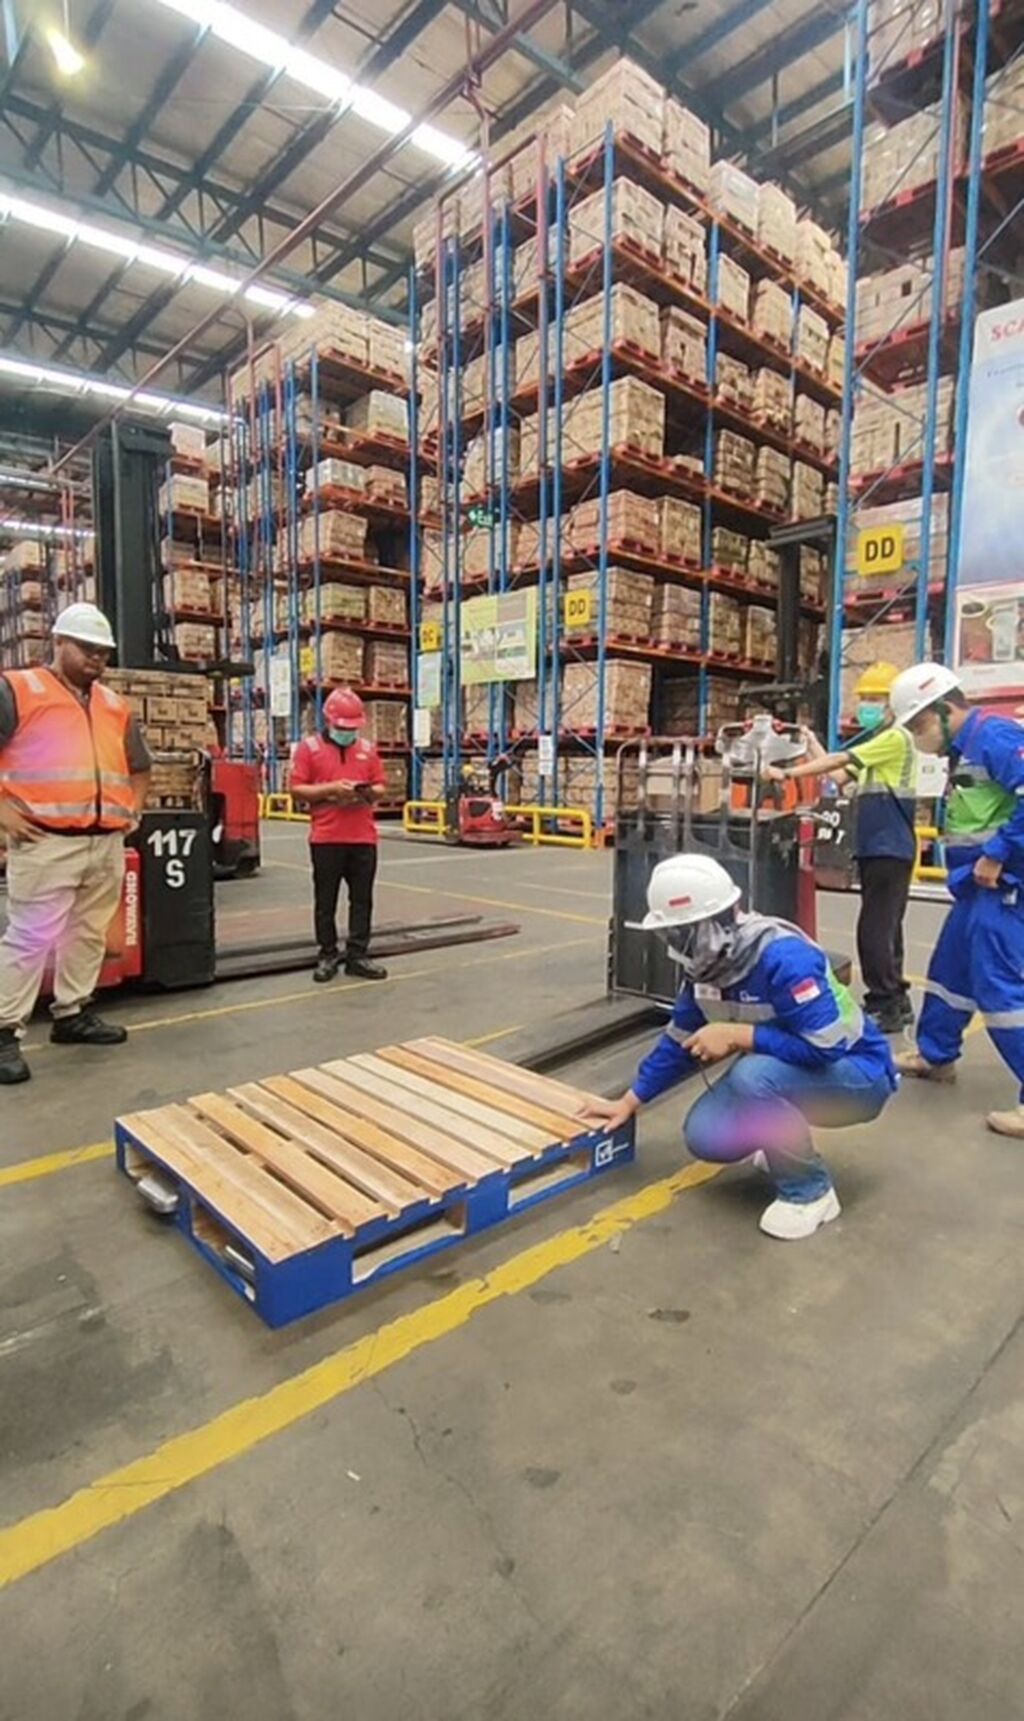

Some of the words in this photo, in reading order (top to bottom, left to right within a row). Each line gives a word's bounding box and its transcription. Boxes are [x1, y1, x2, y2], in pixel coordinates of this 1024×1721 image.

[864, 536, 895, 562] DD
[568, 598, 586, 616] DD
[147, 829, 197, 857] 117
[165, 859, 186, 888] S
